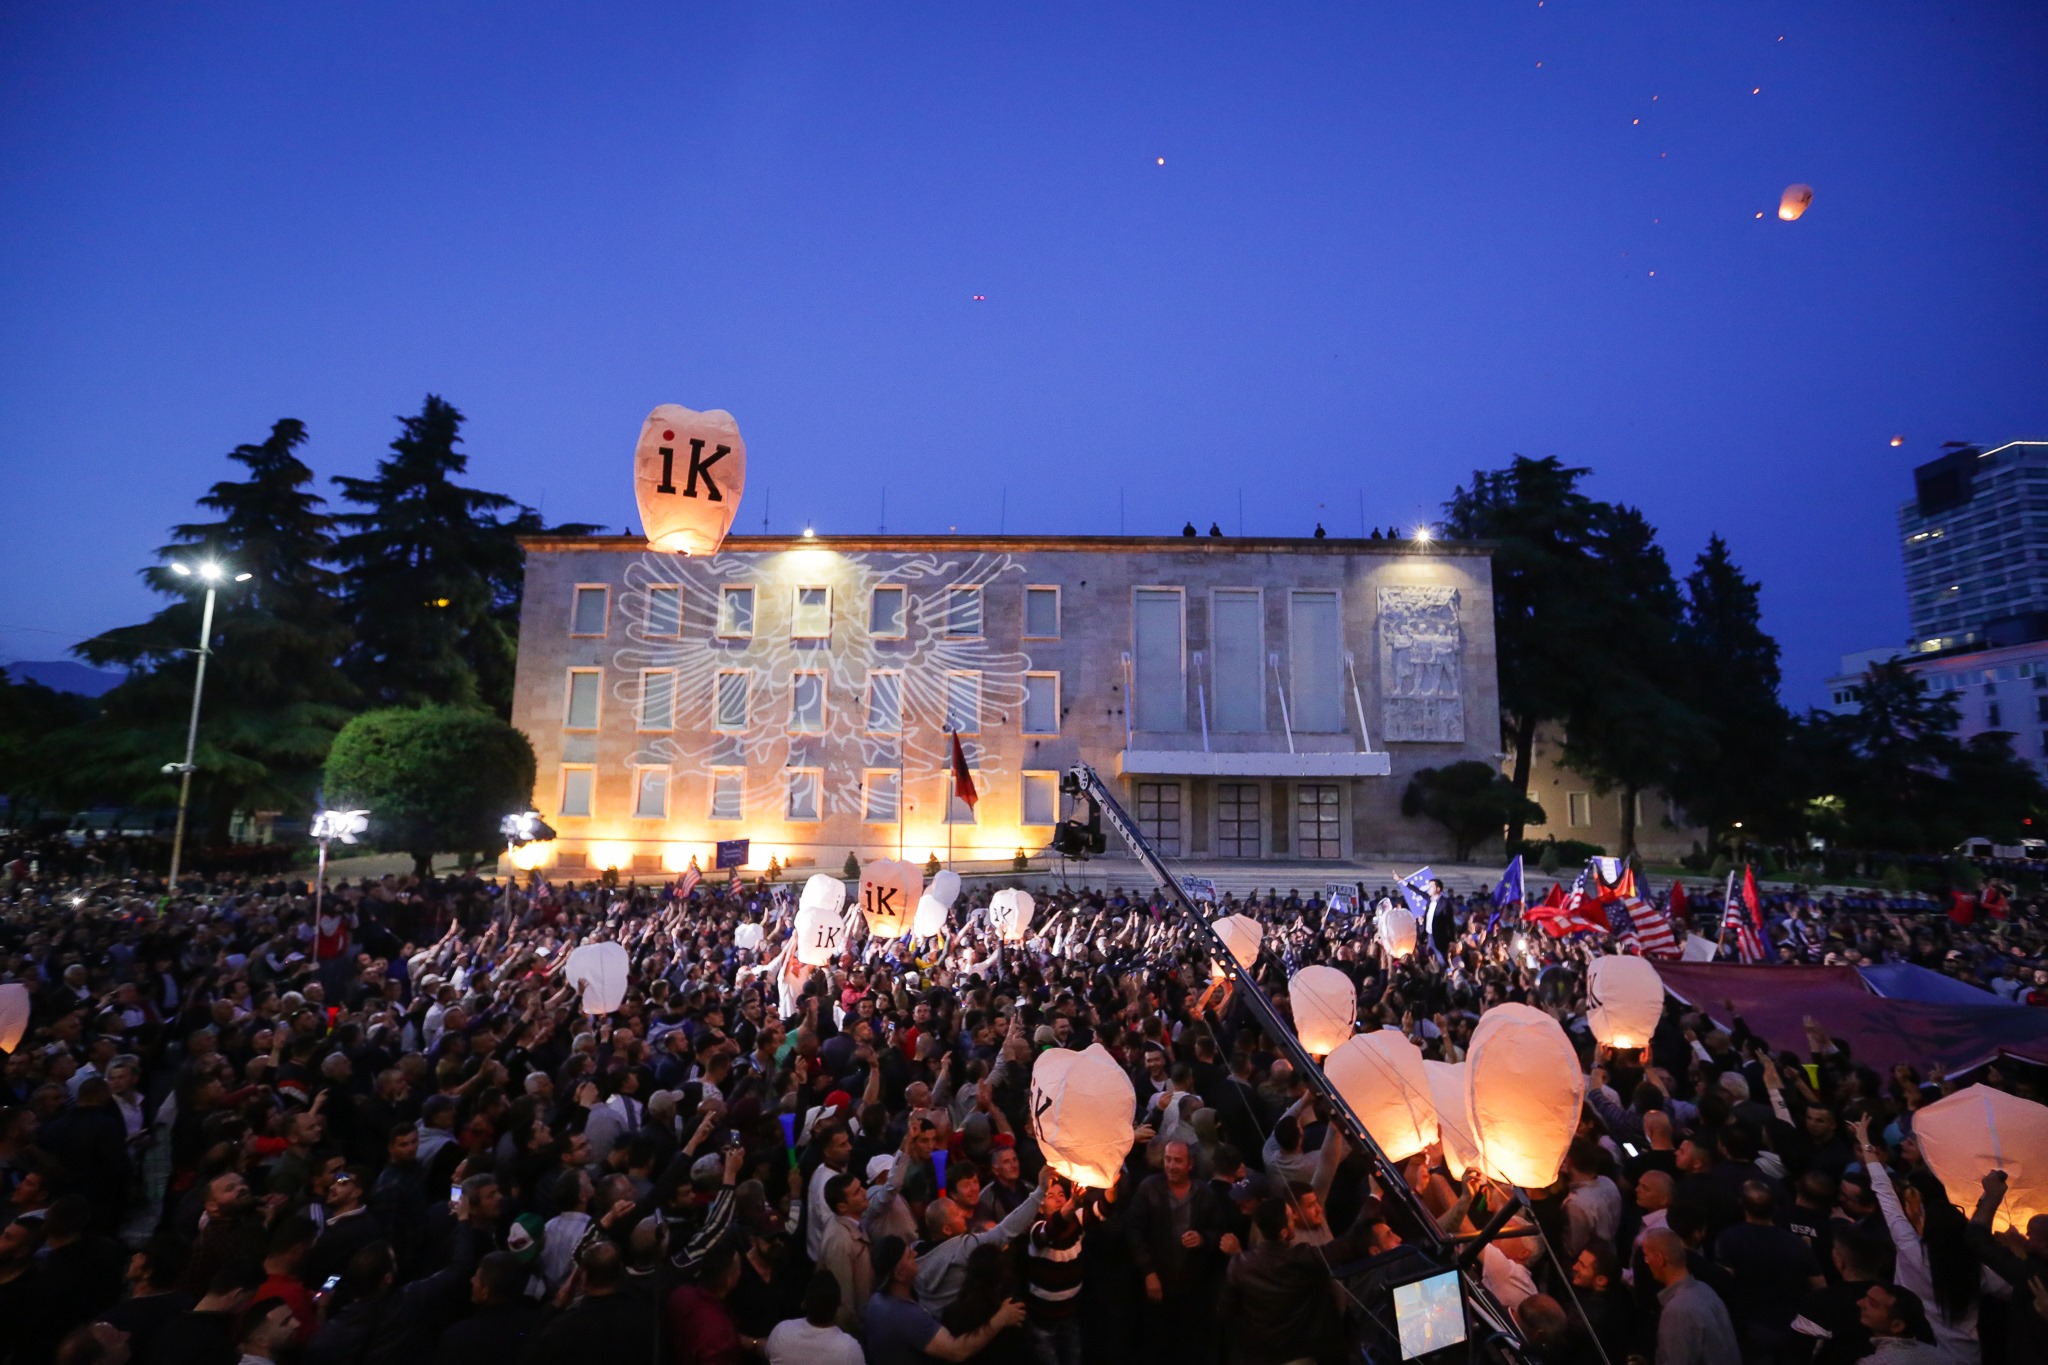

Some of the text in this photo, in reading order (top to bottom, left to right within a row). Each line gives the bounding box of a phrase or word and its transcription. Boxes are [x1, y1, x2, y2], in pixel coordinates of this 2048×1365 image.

[656, 429, 731, 502] iK
[865, 881, 898, 916] iK
[815, 925, 841, 948] iK
